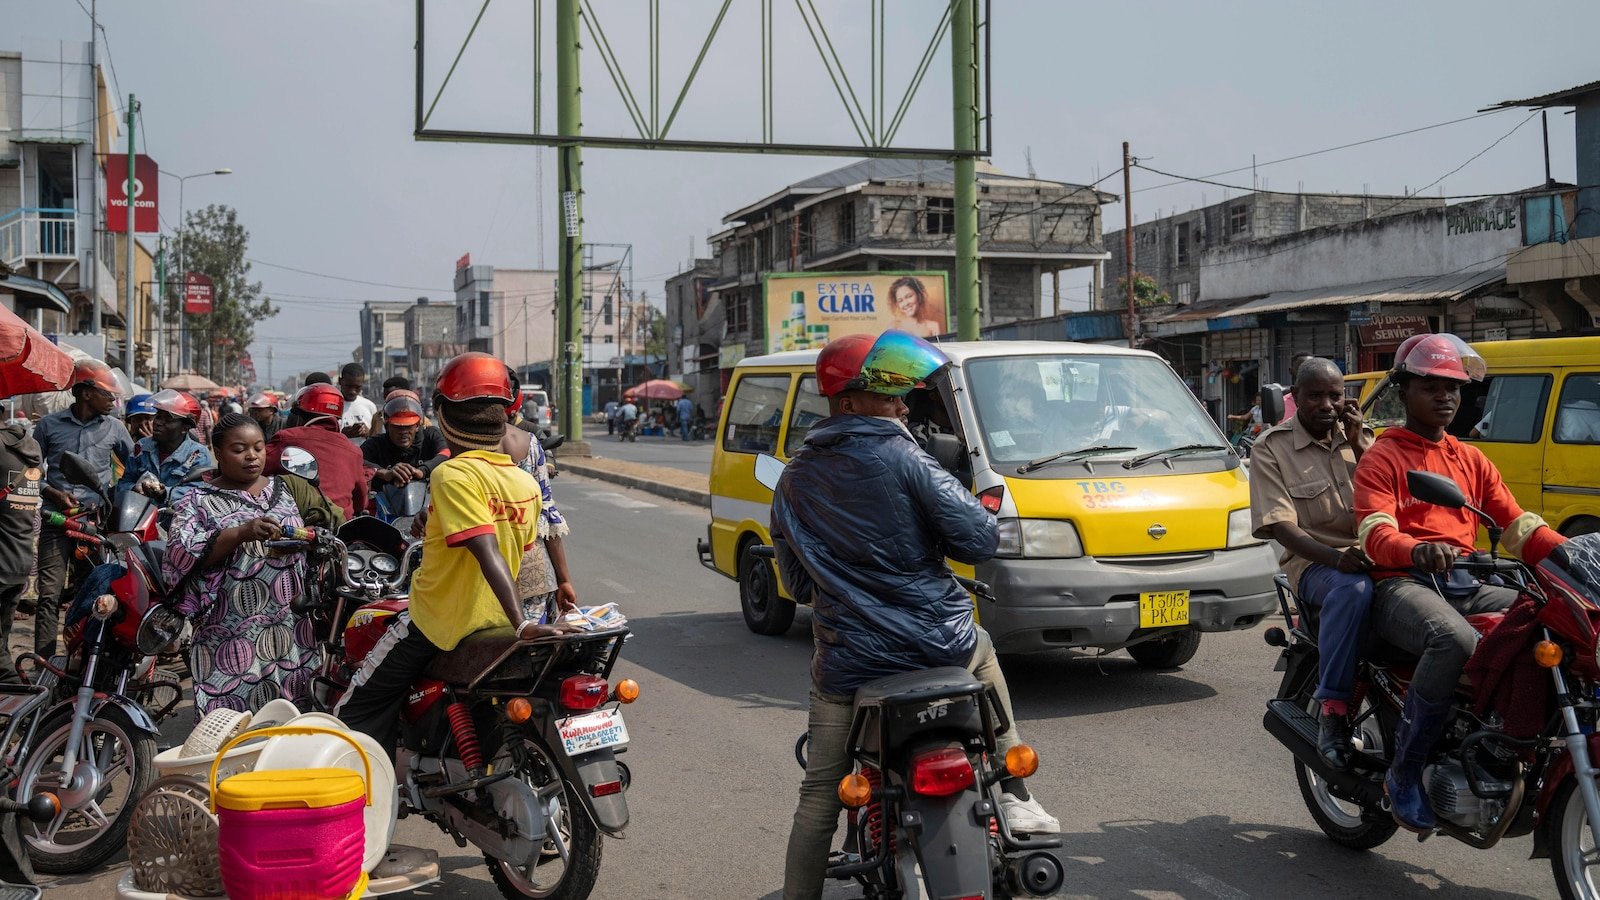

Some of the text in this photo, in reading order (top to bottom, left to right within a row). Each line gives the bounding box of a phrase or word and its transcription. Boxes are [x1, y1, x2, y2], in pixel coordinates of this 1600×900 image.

[110, 199, 155, 208] vodcom
[817, 282, 873, 295] EXTRA
[818, 294, 875, 313] CLAIR
[26, 480, 39, 489] SITE
[1076, 481, 1126, 493] TBG
[917, 704, 948, 724] TVS
